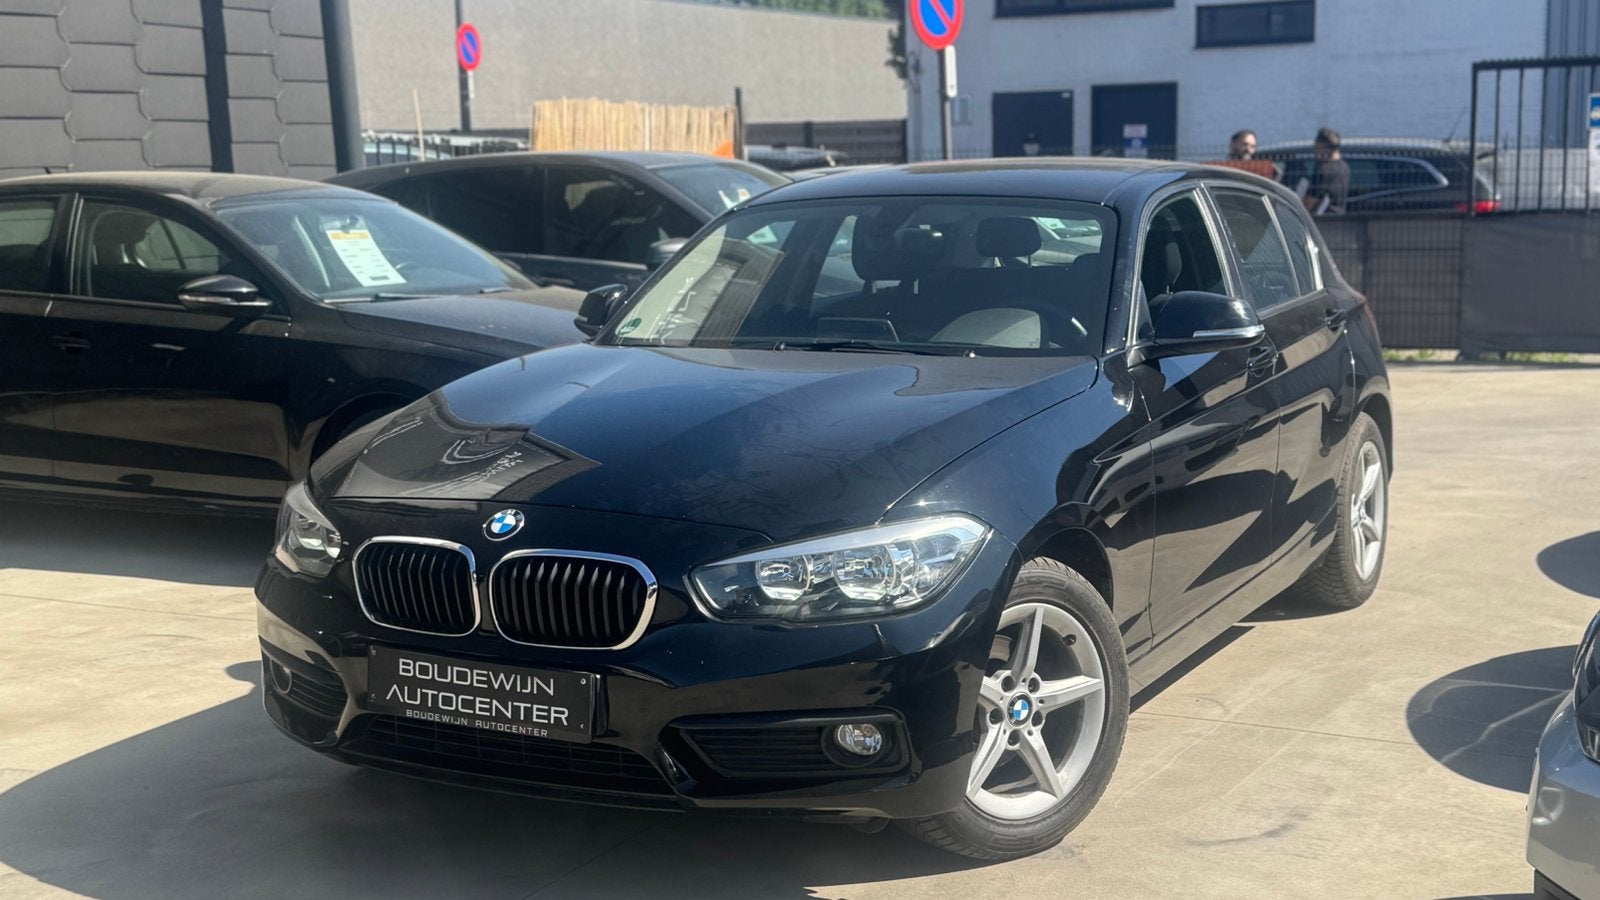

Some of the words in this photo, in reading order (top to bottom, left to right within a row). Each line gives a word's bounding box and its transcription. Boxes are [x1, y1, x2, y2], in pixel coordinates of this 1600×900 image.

[398, 657, 555, 697] BOUDEWIJN
[385, 683, 569, 726] AUTOCENTER
[405, 708, 468, 726] BOUDEWIJN
[475, 719, 549, 737] AUTOCENTER
